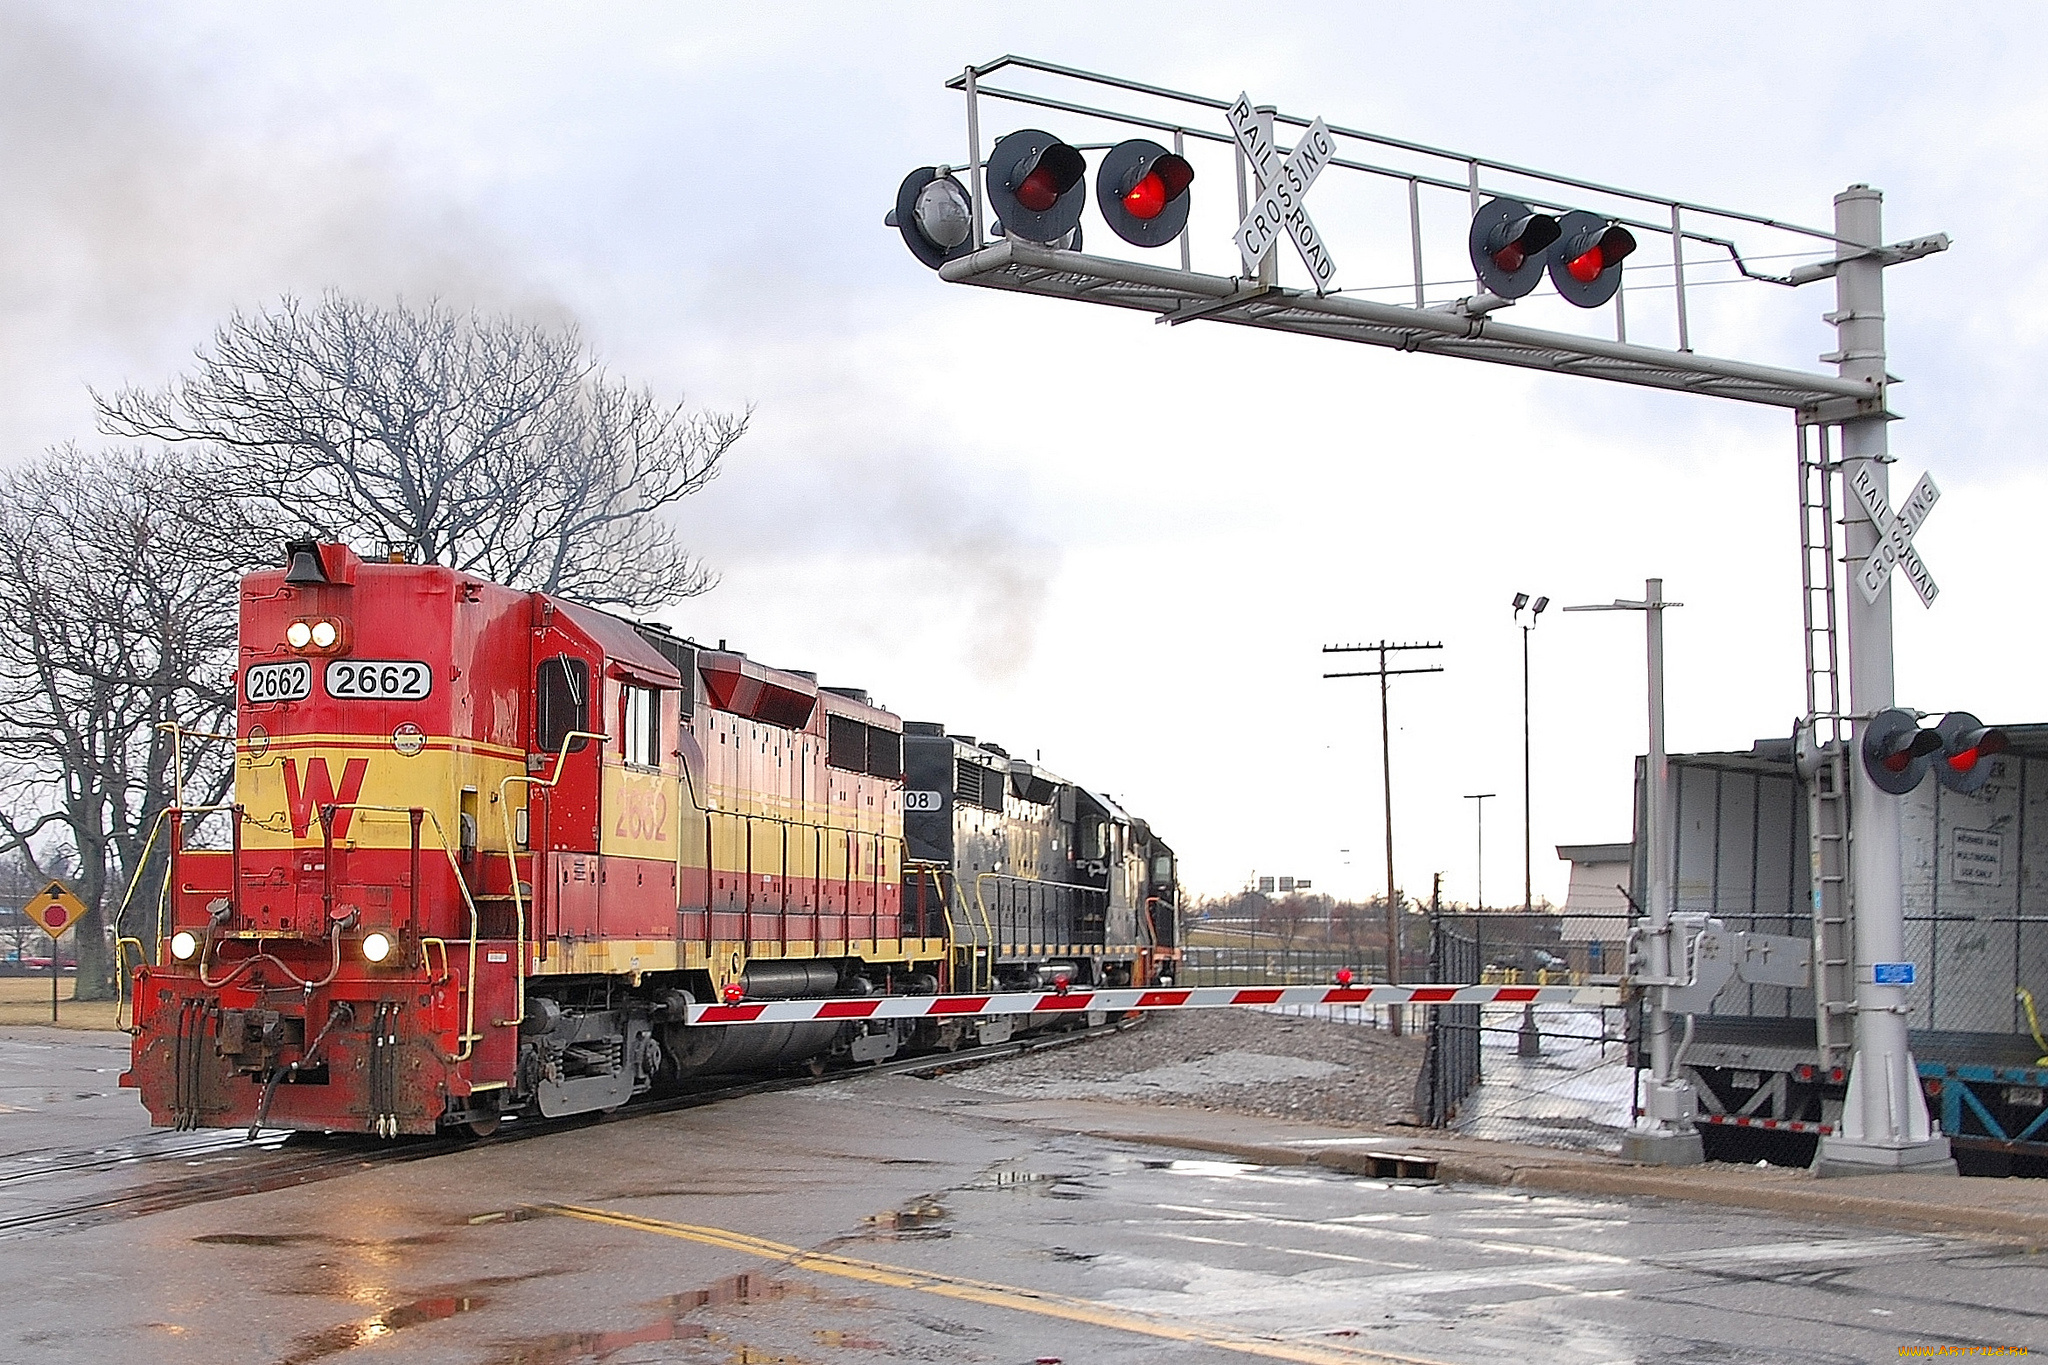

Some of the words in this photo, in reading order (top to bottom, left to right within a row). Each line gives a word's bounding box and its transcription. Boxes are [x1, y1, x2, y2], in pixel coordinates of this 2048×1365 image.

[1233, 100, 1273, 176] RAIL
[1290, 207, 1331, 280] ROAD
[1244, 131, 1329, 255] CROSSING
[1856, 470, 1887, 527] RAIL
[1901, 547, 1936, 601] ROAD
[1865, 484, 1934, 591] CROSSING
[252, 667, 305, 698] 2662
[336, 666, 421, 694] 2662
[283, 757, 370, 839] W
[615, 787, 667, 842] 2662
